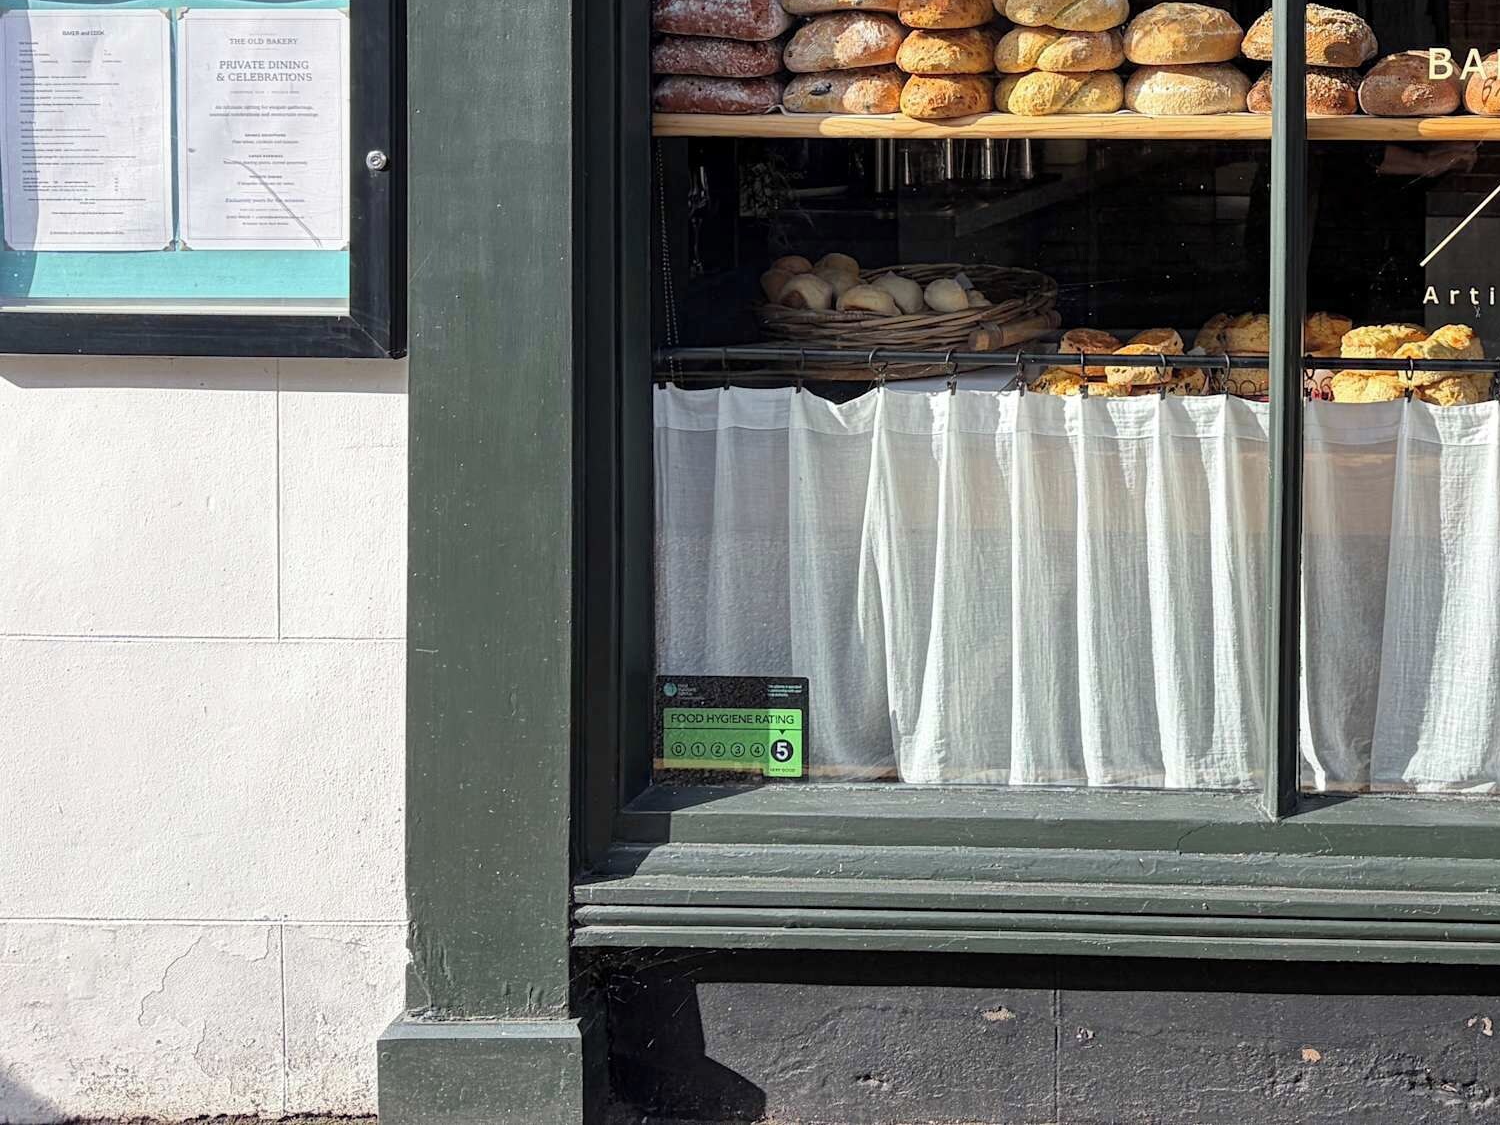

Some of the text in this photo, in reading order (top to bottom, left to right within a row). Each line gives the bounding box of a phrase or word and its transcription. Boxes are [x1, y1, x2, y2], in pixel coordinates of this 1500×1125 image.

[219, 60, 310, 70] PRIVATE DINING
[215, 72, 313, 82] & CELEBRATIONS
[671, 713, 795, 724] FOOD HYGIENE RATING
[775, 741, 789, 762] 5
